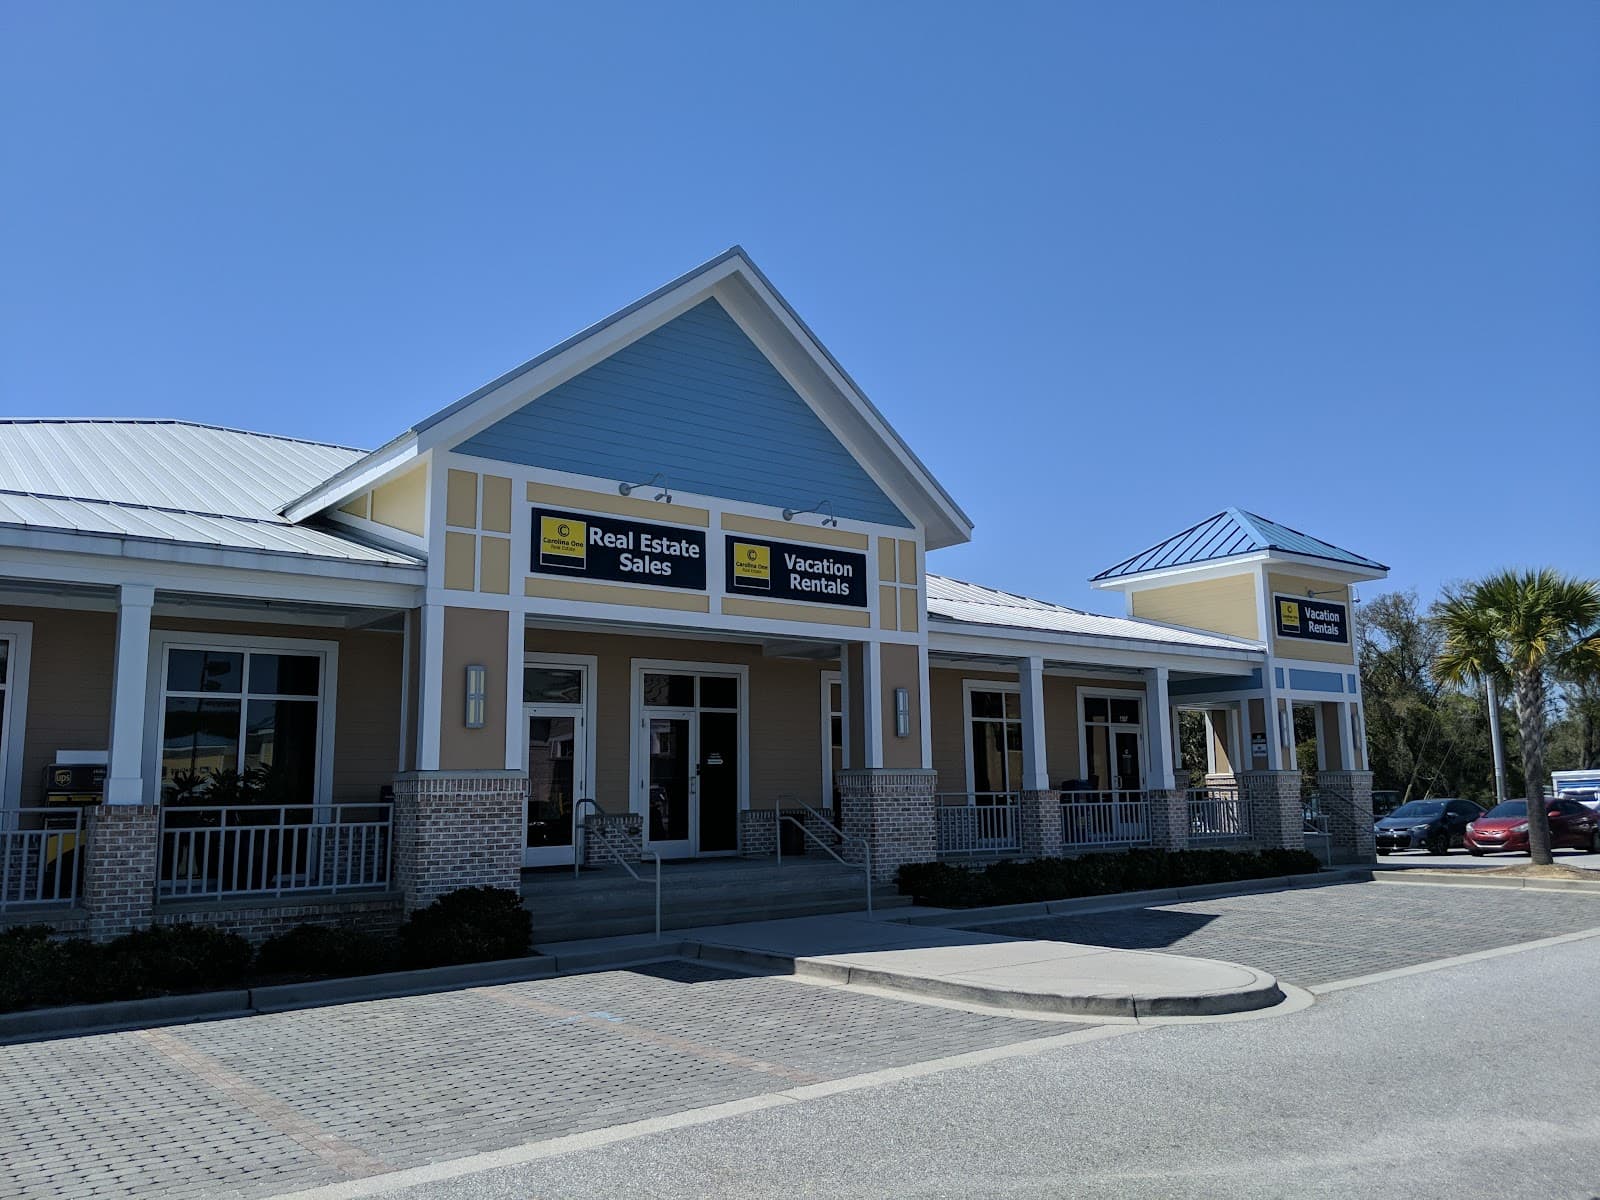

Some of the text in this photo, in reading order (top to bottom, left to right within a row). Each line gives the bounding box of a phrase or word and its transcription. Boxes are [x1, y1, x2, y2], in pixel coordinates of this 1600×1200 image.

[543, 537, 584, 548] Carolina One
[589, 526, 700, 559] Real Estate
[619, 552, 672, 576] Sales
[784, 553, 853, 577] Vacation
[790, 573, 850, 596] Rentals
[1304, 607, 1340, 622] Vacation
[1308, 621, 1339, 635] Rentals
[57, 774, 70, 784] ups
